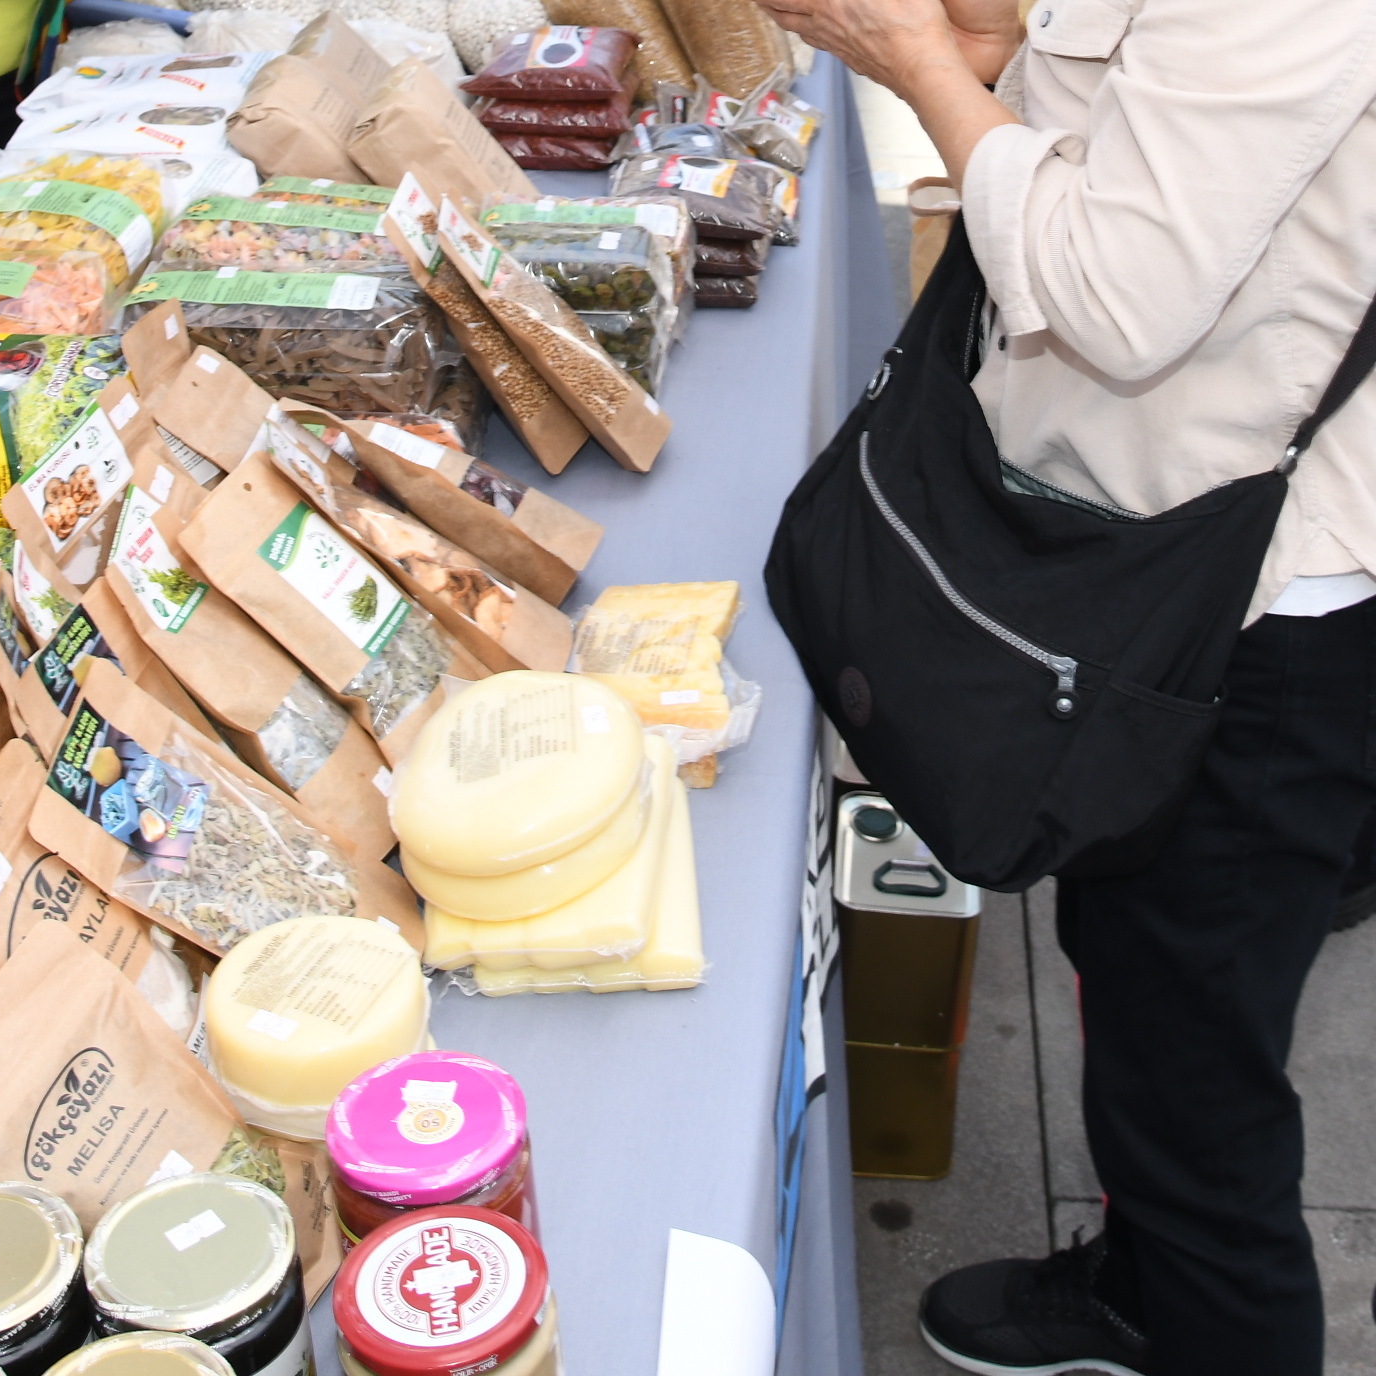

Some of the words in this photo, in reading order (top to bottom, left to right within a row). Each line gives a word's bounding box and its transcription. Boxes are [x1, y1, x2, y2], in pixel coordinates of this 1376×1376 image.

[268, 532, 286, 561] DOĞAL
[278, 536, 296, 564] Natural
[28, 1070, 111, 1174] gökçeyazı
[67, 1103, 127, 1177] MELİSA
[106, 1131, 133, 1166] Kooperatifi
[380, 1245, 413, 1306] HANDMADE
[421, 1225, 459, 1336] HANADE
[459, 1234, 502, 1286] HANDMADE
[390, 1303, 421, 1326] 100%
[468, 1285, 497, 1314] 100%
